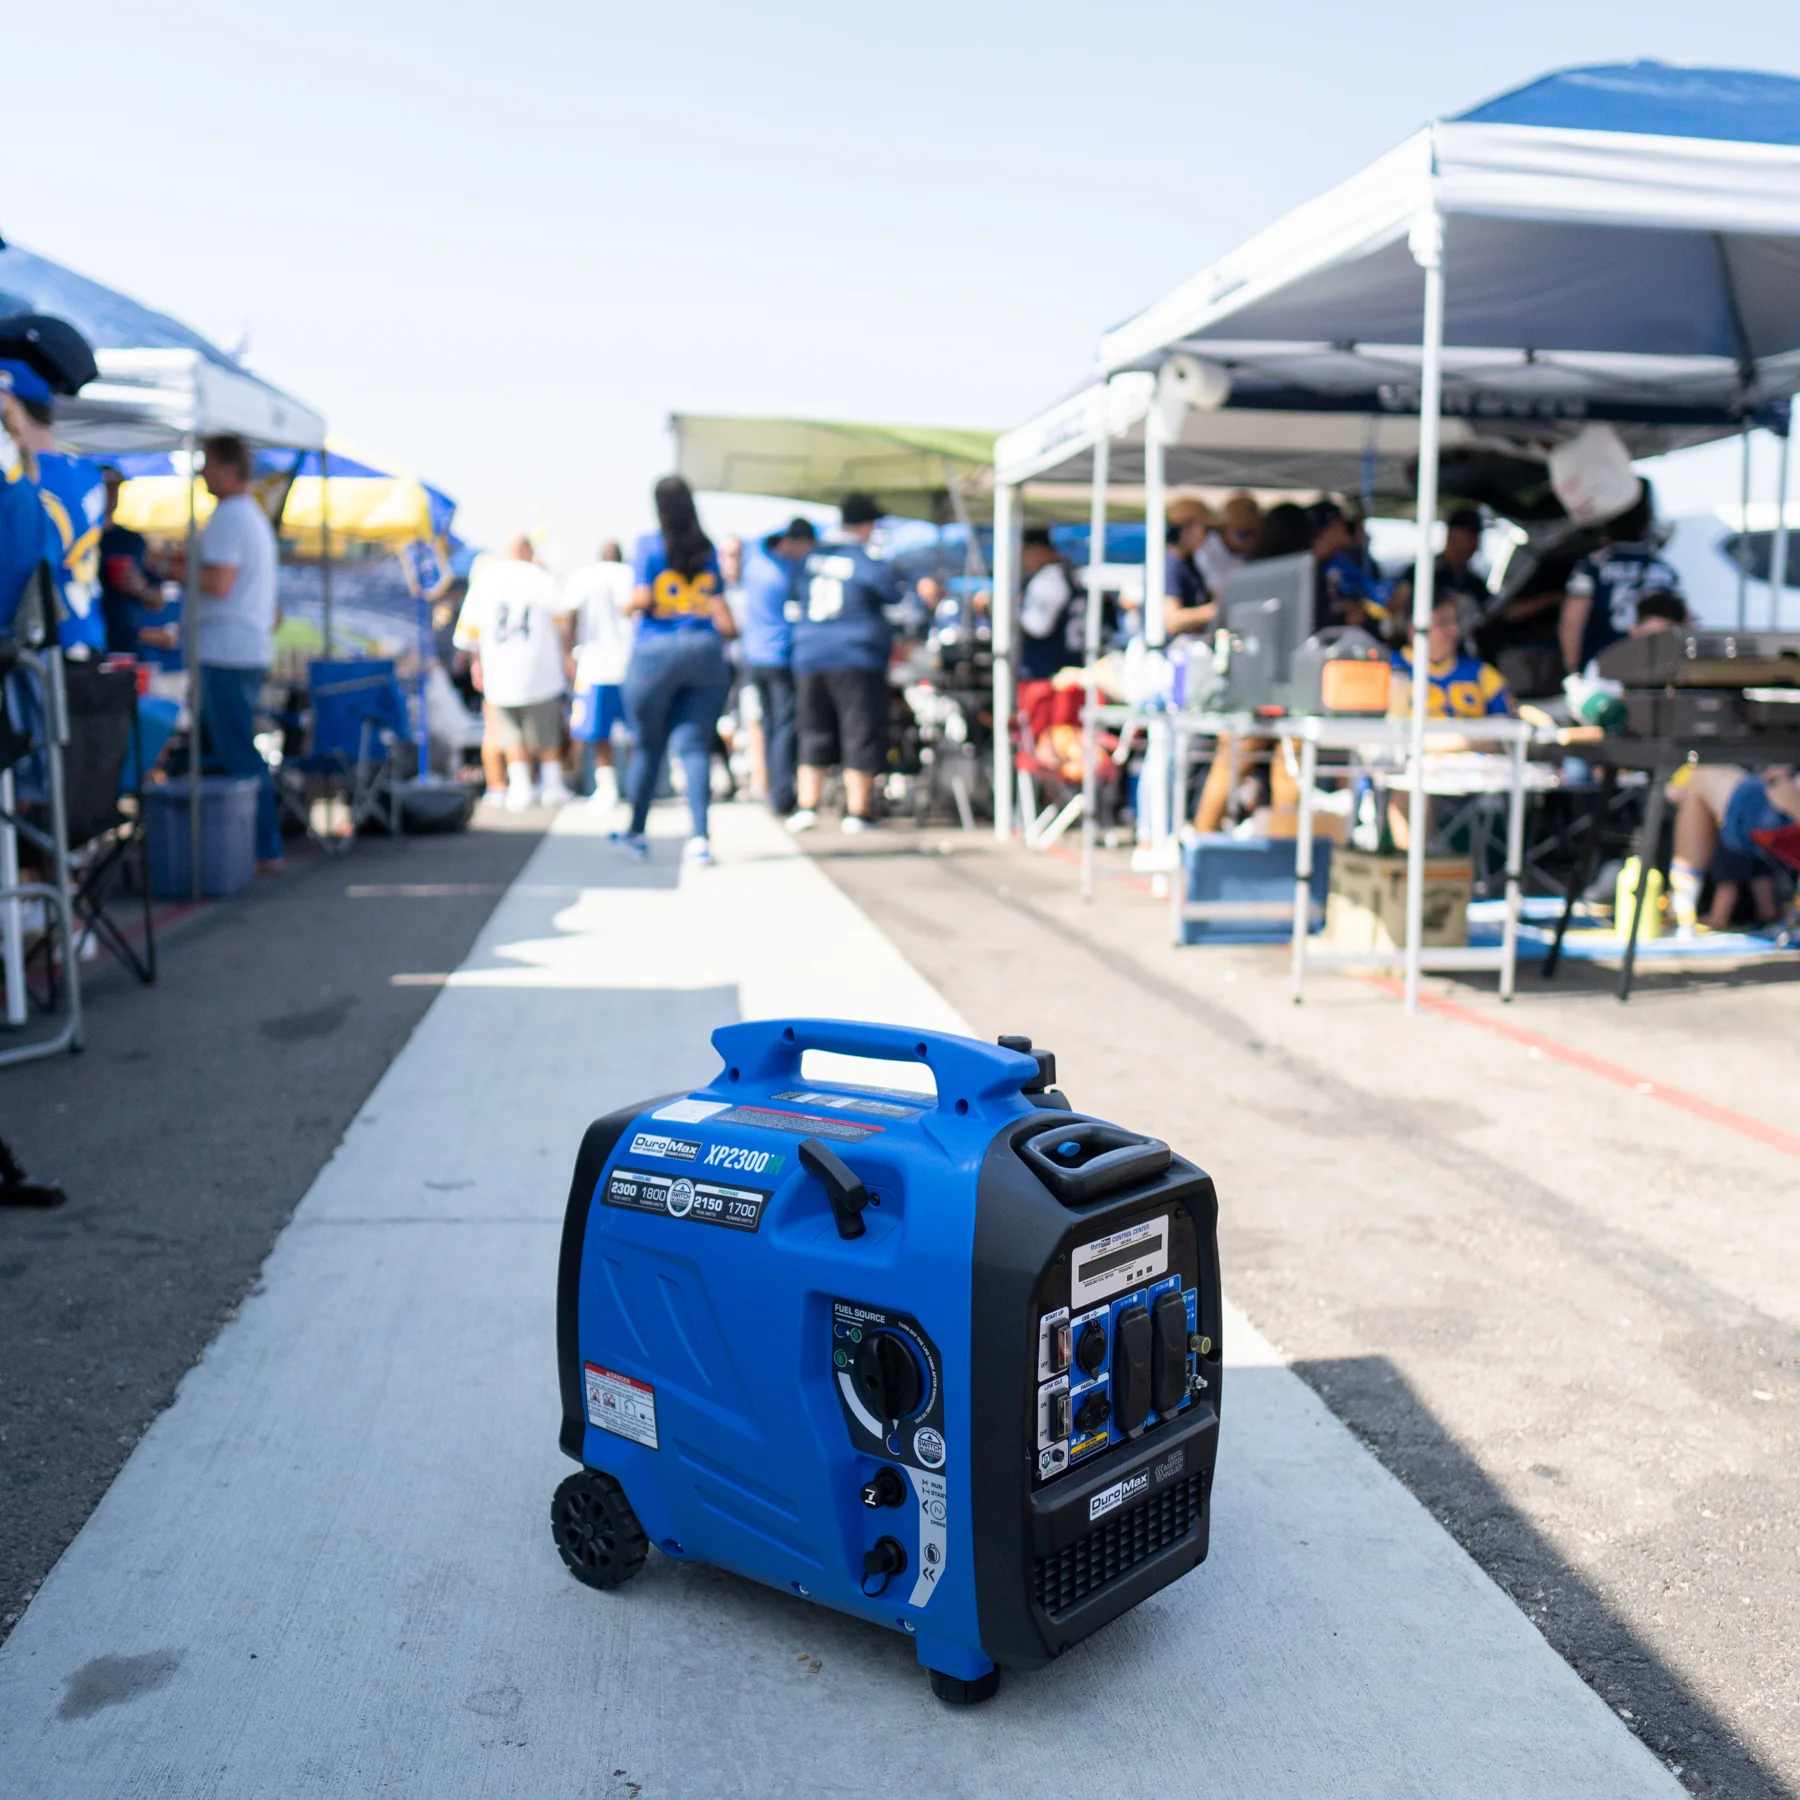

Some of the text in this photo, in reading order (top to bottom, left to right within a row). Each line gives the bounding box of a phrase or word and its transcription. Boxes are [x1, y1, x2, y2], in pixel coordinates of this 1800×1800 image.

[632, 1174, 652, 1182] GASOLINE
[610, 1182, 666, 1202] 2300 1800
[718, 1188, 738, 1197] PROPANE
[694, 1196, 756, 1218] 2150 1700
[1112, 1230, 1132, 1242] CONTROL
[1132, 1224, 1150, 1234] CENTER
[834, 1303, 886, 1324] FUEL SOURCE
[1045, 1309, 1064, 1322] START UP
[1082, 1314, 1090, 1322] USB
[898, 1321, 910, 1332] TURN
[908, 1329, 917, 1337] OFF
[1044, 1378, 1063, 1391] LOW IDLE
[918, 1440, 942, 1452] SWITCH
[1168, 1449, 1182, 1462] DIGITAL
[1164, 1456, 1184, 1472] INVERTER
[1156, 1462, 1183, 1483] TECHNOLOGY
[931, 1482, 942, 1490] RUN
[931, 1490, 947, 1499] START
[1123, 1490, 1134, 1499] POWER
[1101, 1498, 1120, 1511] GENERATION
[930, 1520, 946, 1528] CHOKE
